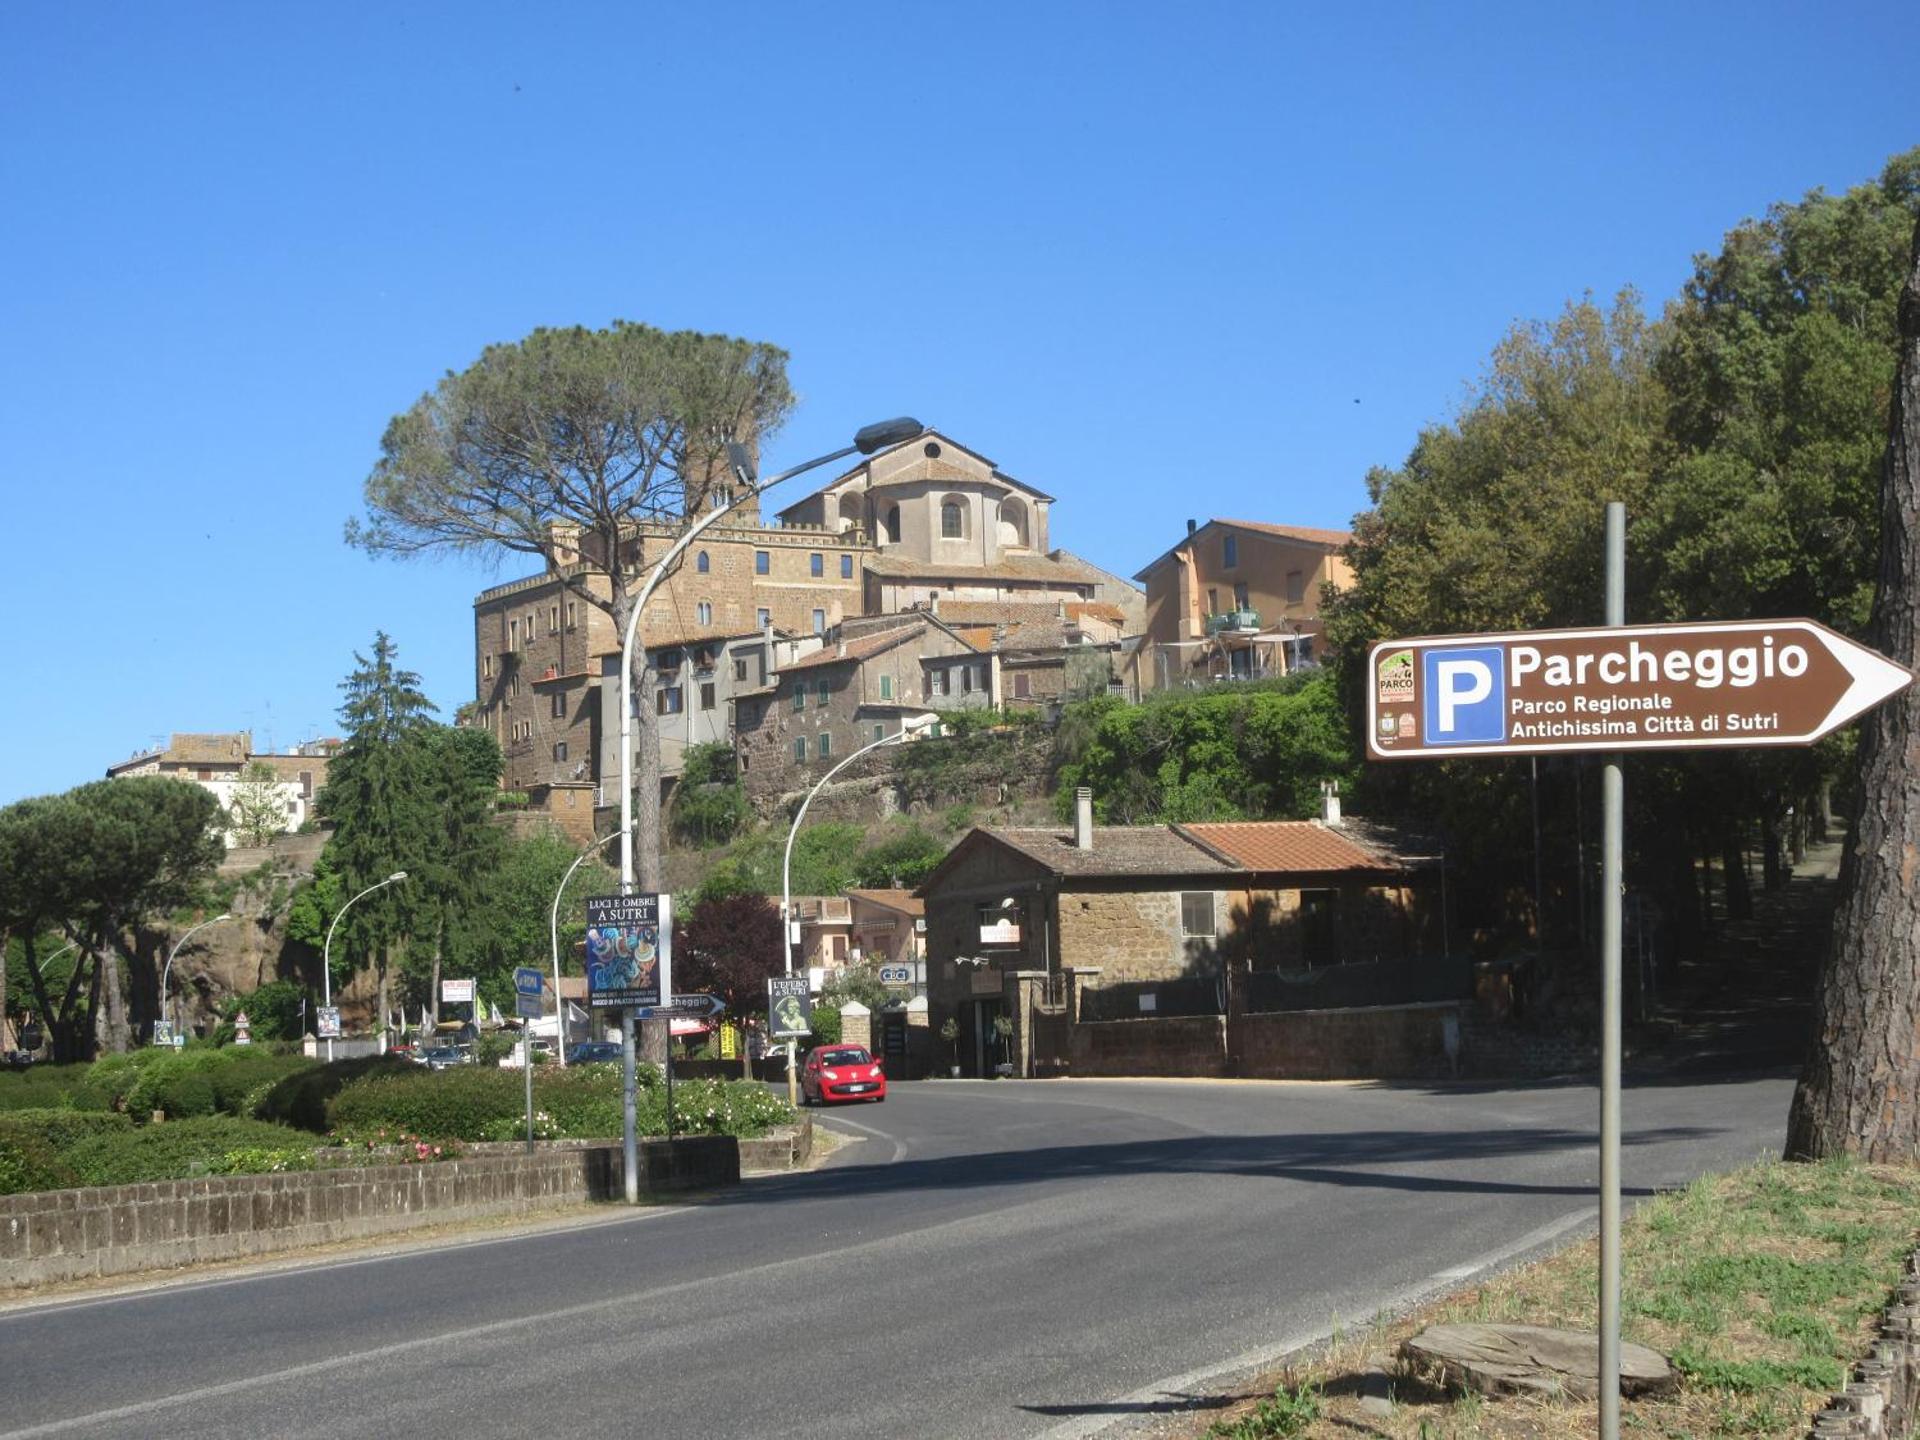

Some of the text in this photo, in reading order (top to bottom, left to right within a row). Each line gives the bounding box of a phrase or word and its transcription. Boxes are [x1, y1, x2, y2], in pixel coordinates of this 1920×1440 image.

[1510, 636, 1809, 689] Parcheggio
[1380, 679, 1413, 689] PARCO
[1437, 659, 1492, 733] P
[1511, 694, 1672, 715] Parco Regionale
[1511, 712, 1778, 738] Antichissima Città di Sutri
[622, 897, 656, 907] OMBRE
[598, 908, 648, 921] A SUTRI
